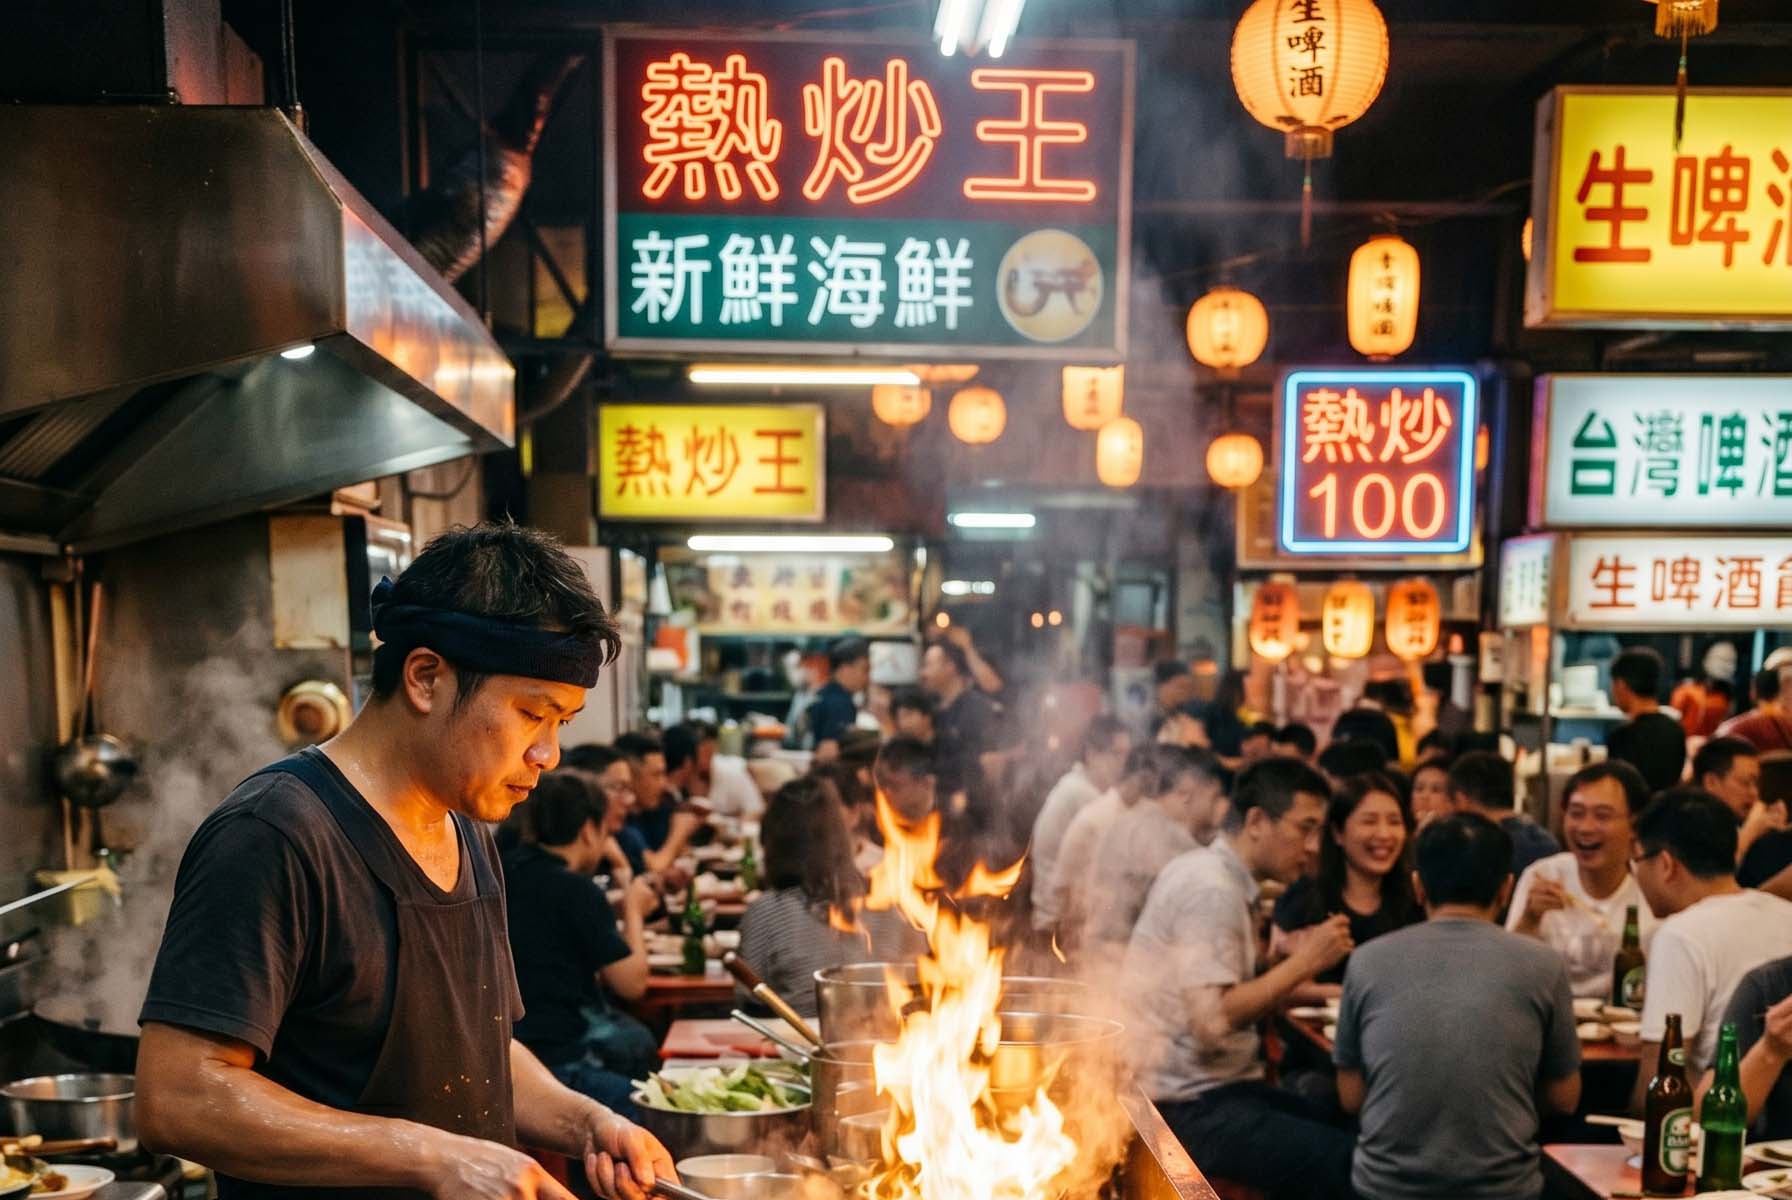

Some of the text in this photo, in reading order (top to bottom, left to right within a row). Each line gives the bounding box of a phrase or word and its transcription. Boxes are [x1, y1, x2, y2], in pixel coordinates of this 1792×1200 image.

[641, 52, 1097, 204] 熱炒王
[631, 230, 974, 330] 新鮮海鮮
[614, 424, 806, 498] 熱炒王
[1302, 387, 1452, 465] 熱炒
[1308, 472, 1447, 539] 100
